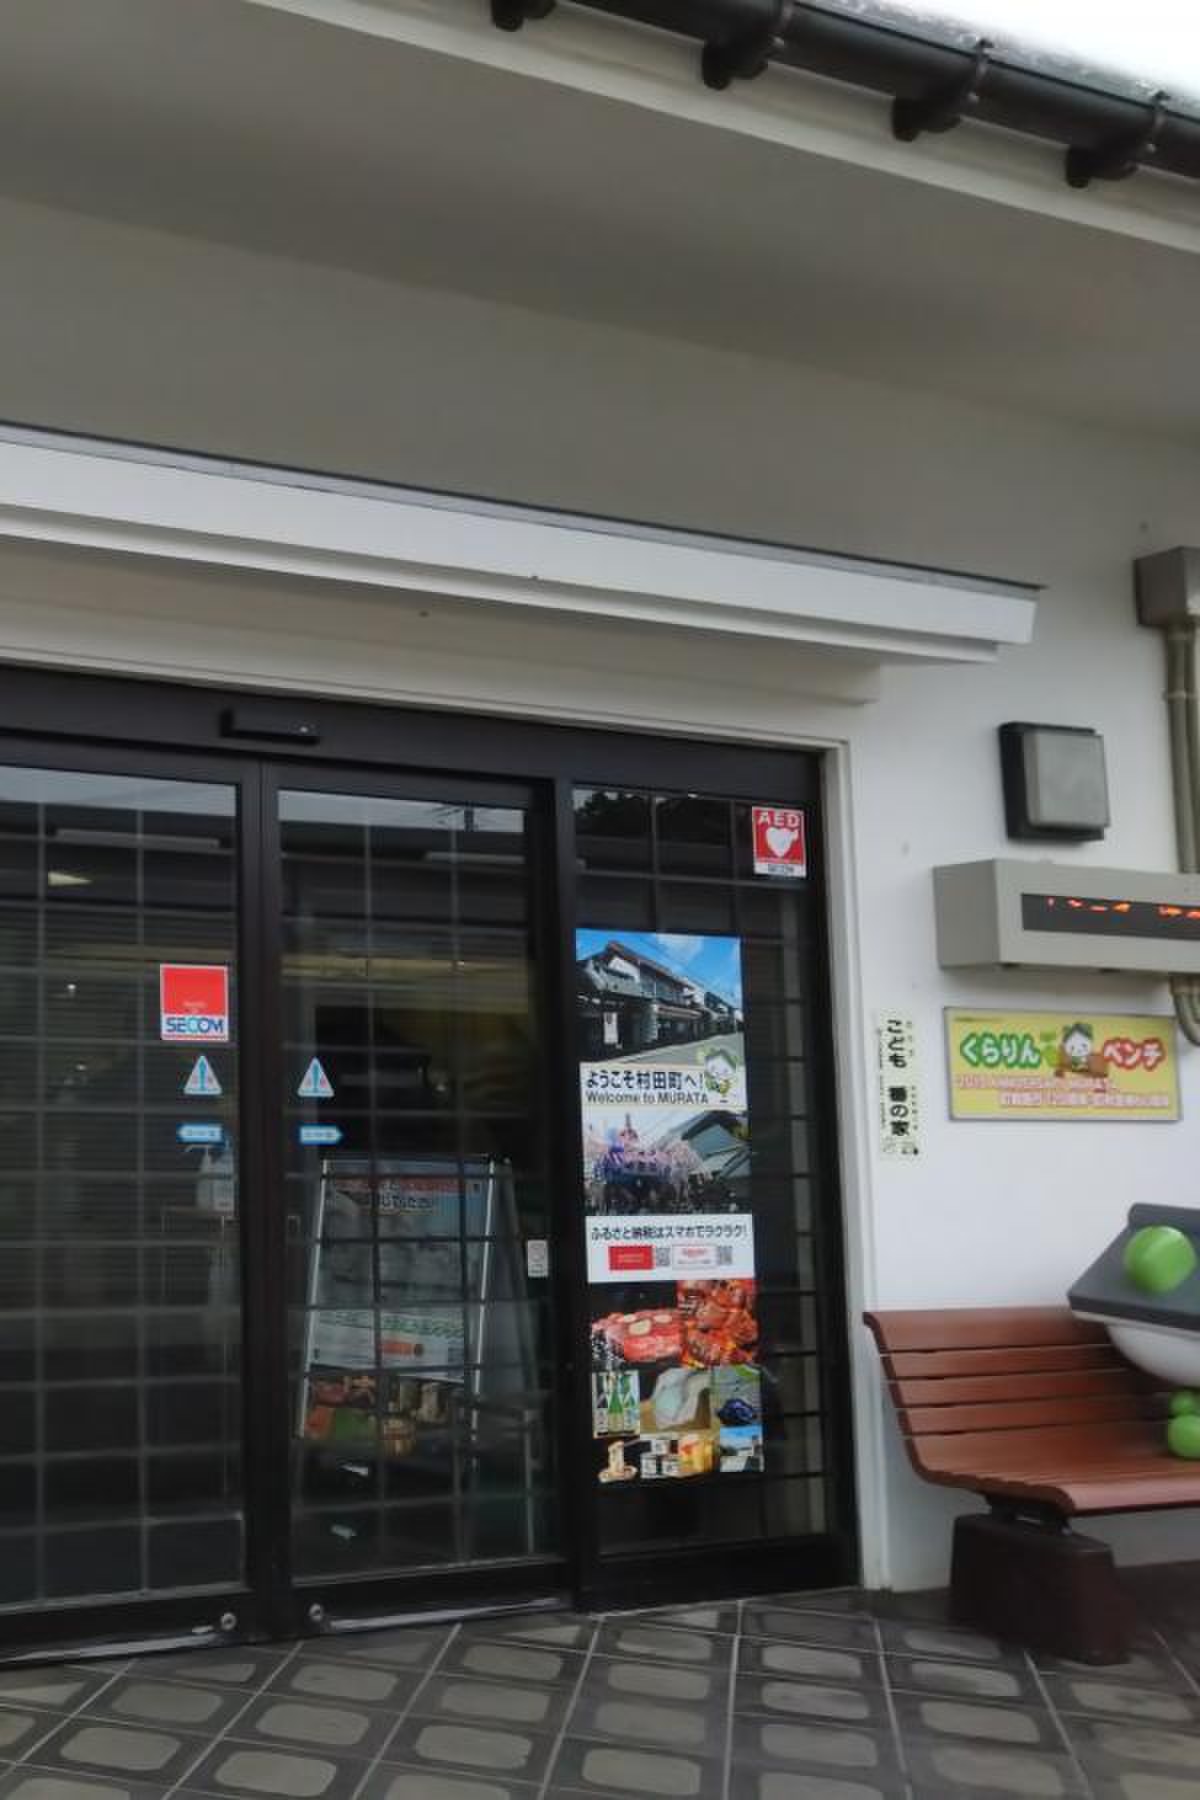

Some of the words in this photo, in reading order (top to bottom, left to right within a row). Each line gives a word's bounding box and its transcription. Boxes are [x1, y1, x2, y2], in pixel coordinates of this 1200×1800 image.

[757, 810, 801, 828] AED
[166, 1017, 224, 1034] SECOM
[959, 1032, 1042, 1069] くらりん
[585, 1090, 640, 1105] Welcome
[643, 1091, 655, 1105] to
[657, 1092, 709, 1105] MURATA
